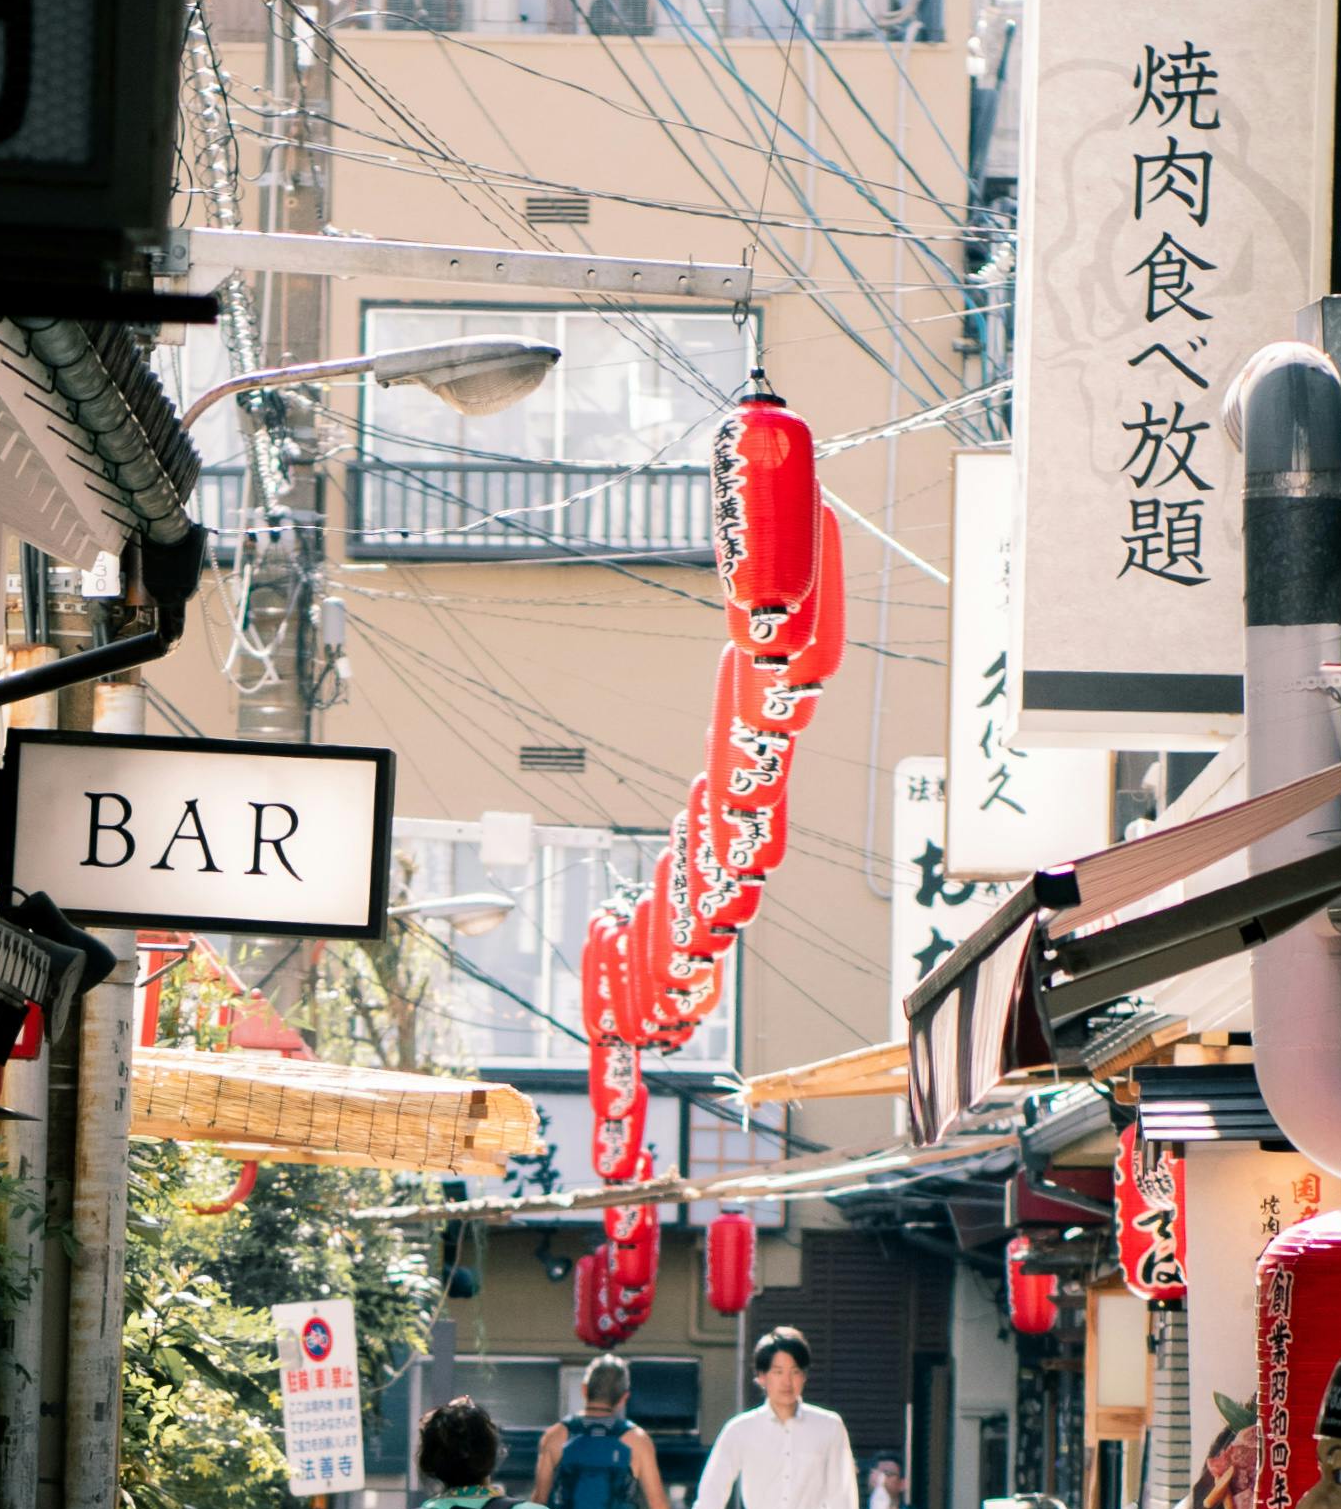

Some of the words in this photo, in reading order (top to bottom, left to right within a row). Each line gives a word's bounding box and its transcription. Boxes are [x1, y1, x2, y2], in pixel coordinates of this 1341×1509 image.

[1117, 40, 1220, 587] 焼肉食べ放題
[80, 792, 303, 882] BAR
[300, 1455, 353, 1480] 法善寺
